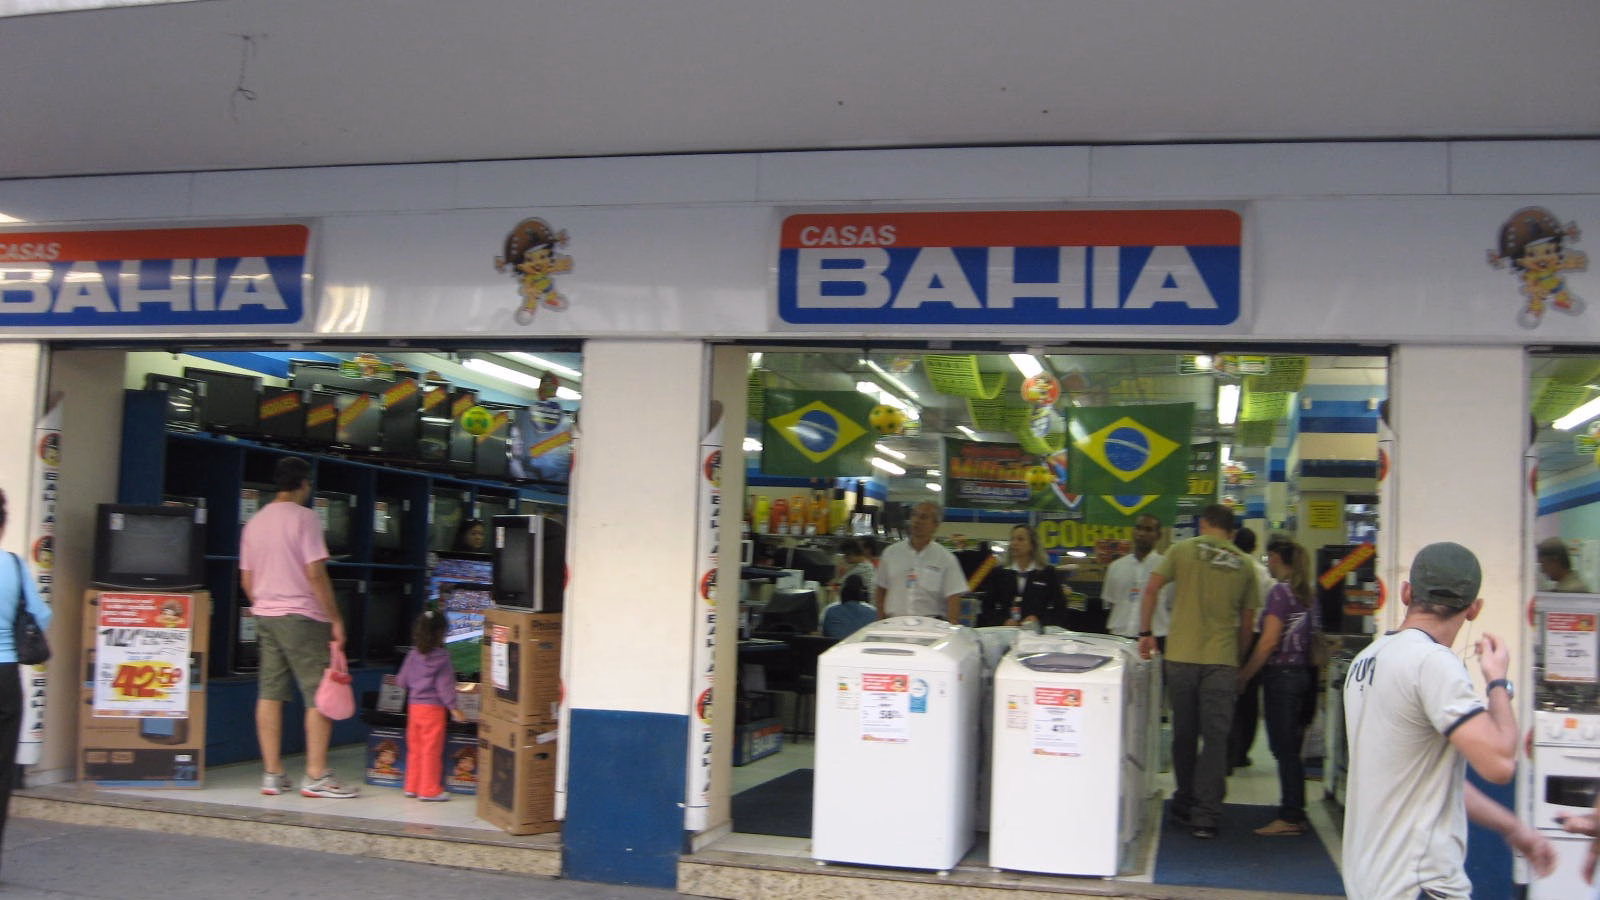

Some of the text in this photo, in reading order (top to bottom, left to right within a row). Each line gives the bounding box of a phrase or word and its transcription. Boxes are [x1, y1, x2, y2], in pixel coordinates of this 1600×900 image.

[0, 242, 61, 260] CASAS
[800, 225, 897, 247] CASAS
[0, 256, 289, 314] BAHIA
[796, 245, 1219, 309] BAHIA
